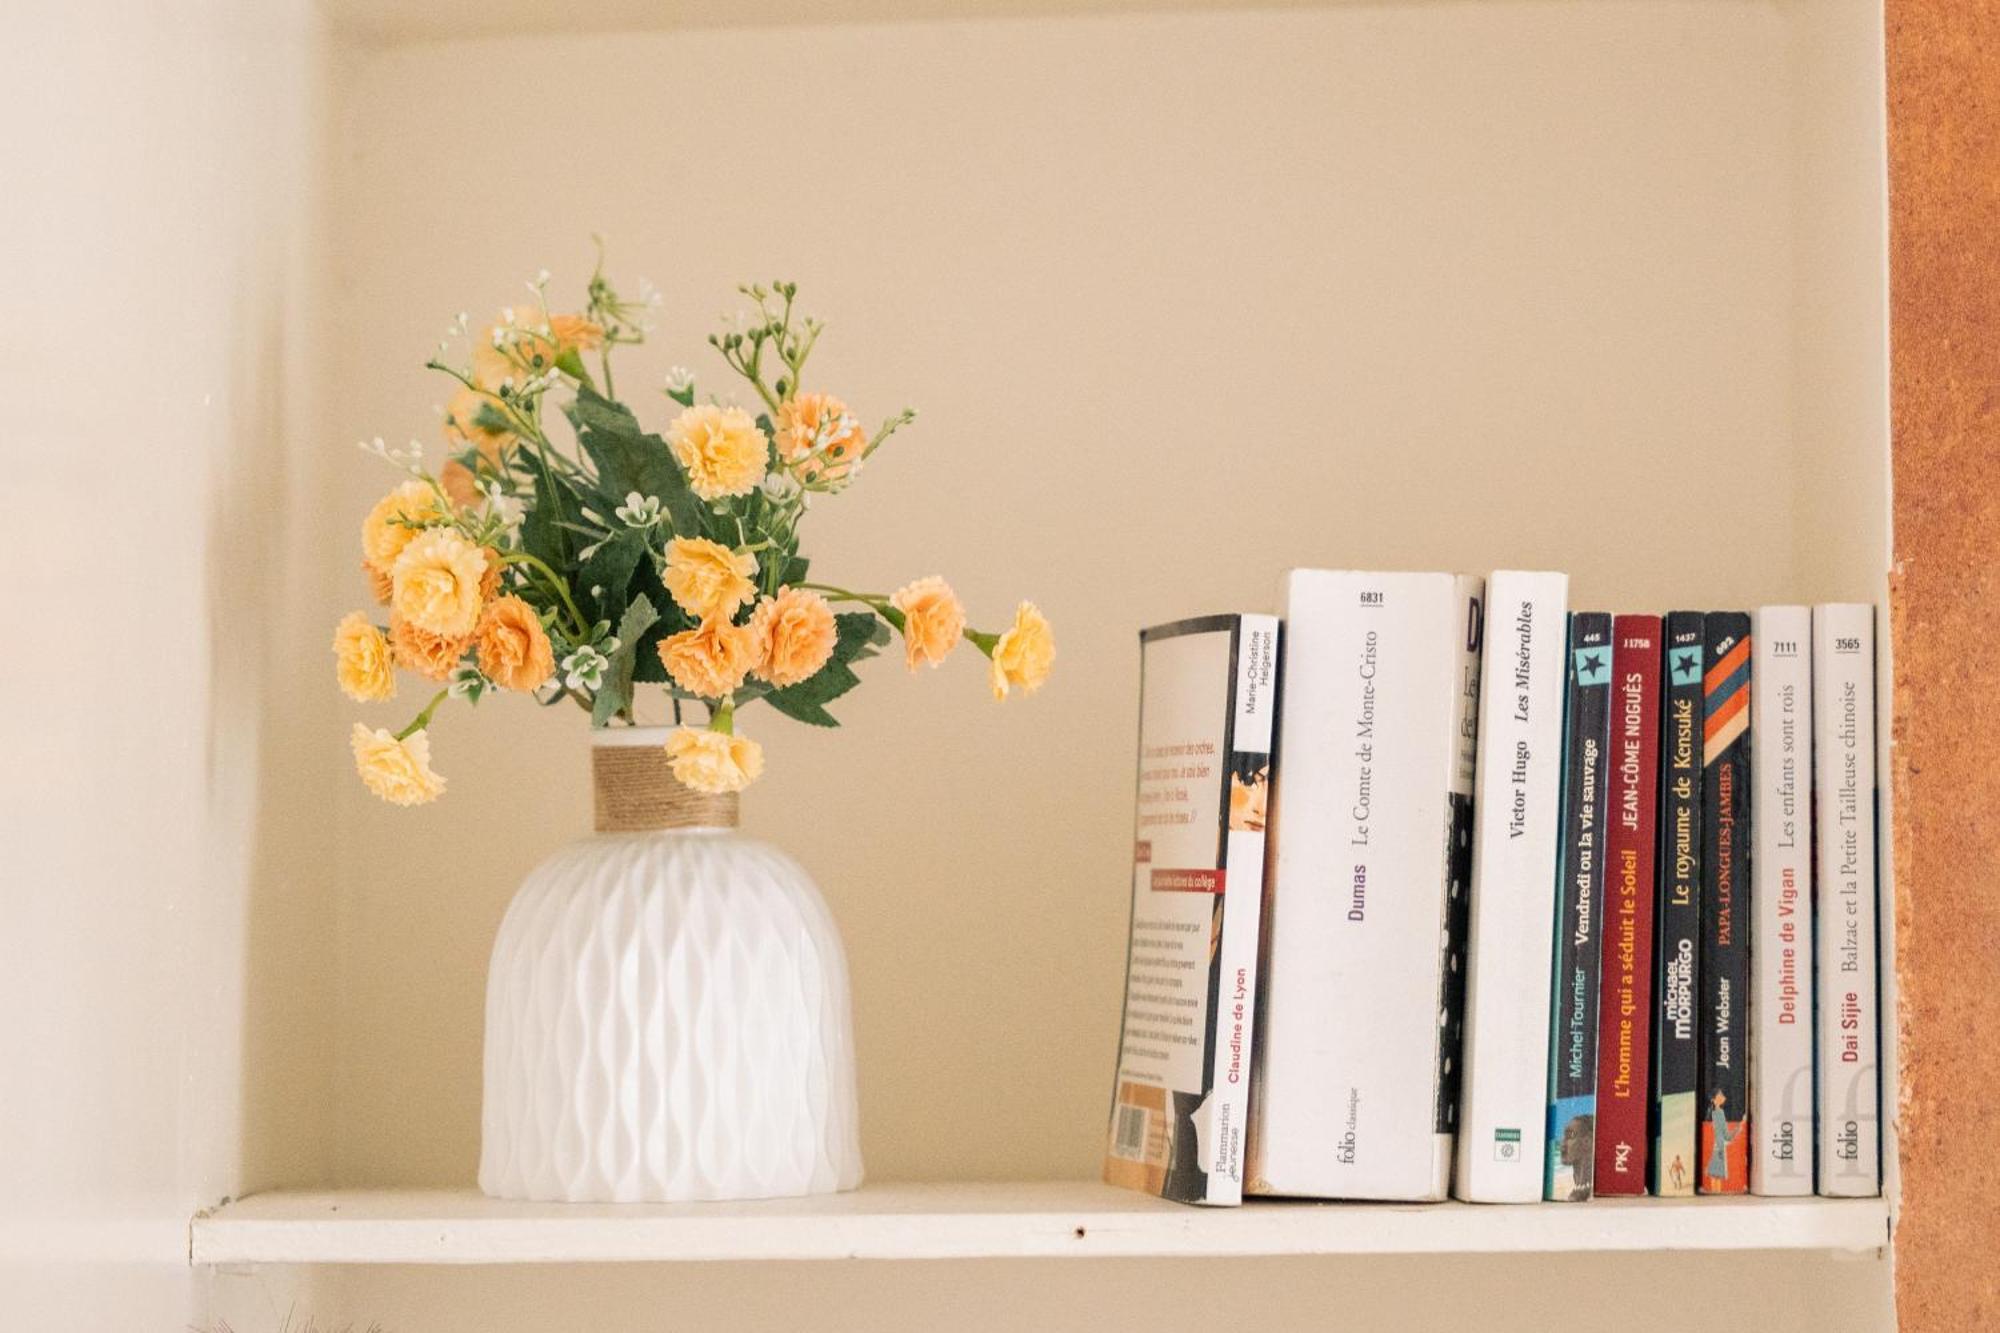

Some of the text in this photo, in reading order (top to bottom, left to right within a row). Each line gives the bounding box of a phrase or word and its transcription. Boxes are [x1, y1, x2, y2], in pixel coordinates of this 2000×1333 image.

[1360, 592, 1384, 603] 6831
[1675, 633, 1695, 643] 1437
[1246, 630, 1260, 714] Marie-Christine
[1260, 631, 1273, 686] Helgerson
[1514, 601, 1533, 722] Les Misérables
[1774, 641, 1797, 653] 7111
[1836, 638, 1860, 650] 3565
[1351, 631, 1377, 846] Le Comte de Monte-Cristo
[1620, 673, 1642, 831] JEAN-CÔME NOGUÈS
[1777, 685, 1795, 848] Les enfants sont rois
[1510, 741, 1530, 839] Victor Hugo
[1672, 698, 1695, 905] Le royaume de Kensuké
[1839, 682, 1858, 972] Balzac et la Petite Tailleuse chinoise
[1575, 739, 1598, 945] Vendredi ou la vie sauvage
[1719, 763, 1734, 945] PAPA-LONGUES-JAMBES
[1348, 865, 1366, 922] Dumas
[1615, 850, 1637, 1098] L'homme qui a séduit le Soleil
[1779, 868, 1798, 1024] Delphine de Vigan
[1228, 968, 1247, 1084] Claudine de Lyon
[1569, 967, 1585, 1077] Michel Tournier
[1716, 977, 1730, 1069] Jean Webster
[1842, 992, 1861, 1062] Dai Sijie
[1216, 1103, 1230, 1174] Flammarion
[1228, 1128, 1240, 1182] jeunesse
[1337, 1132, 1356, 1164] folio
[1772, 1121, 1794, 1161] folio
[1837, 1120, 1858, 1161] folio
